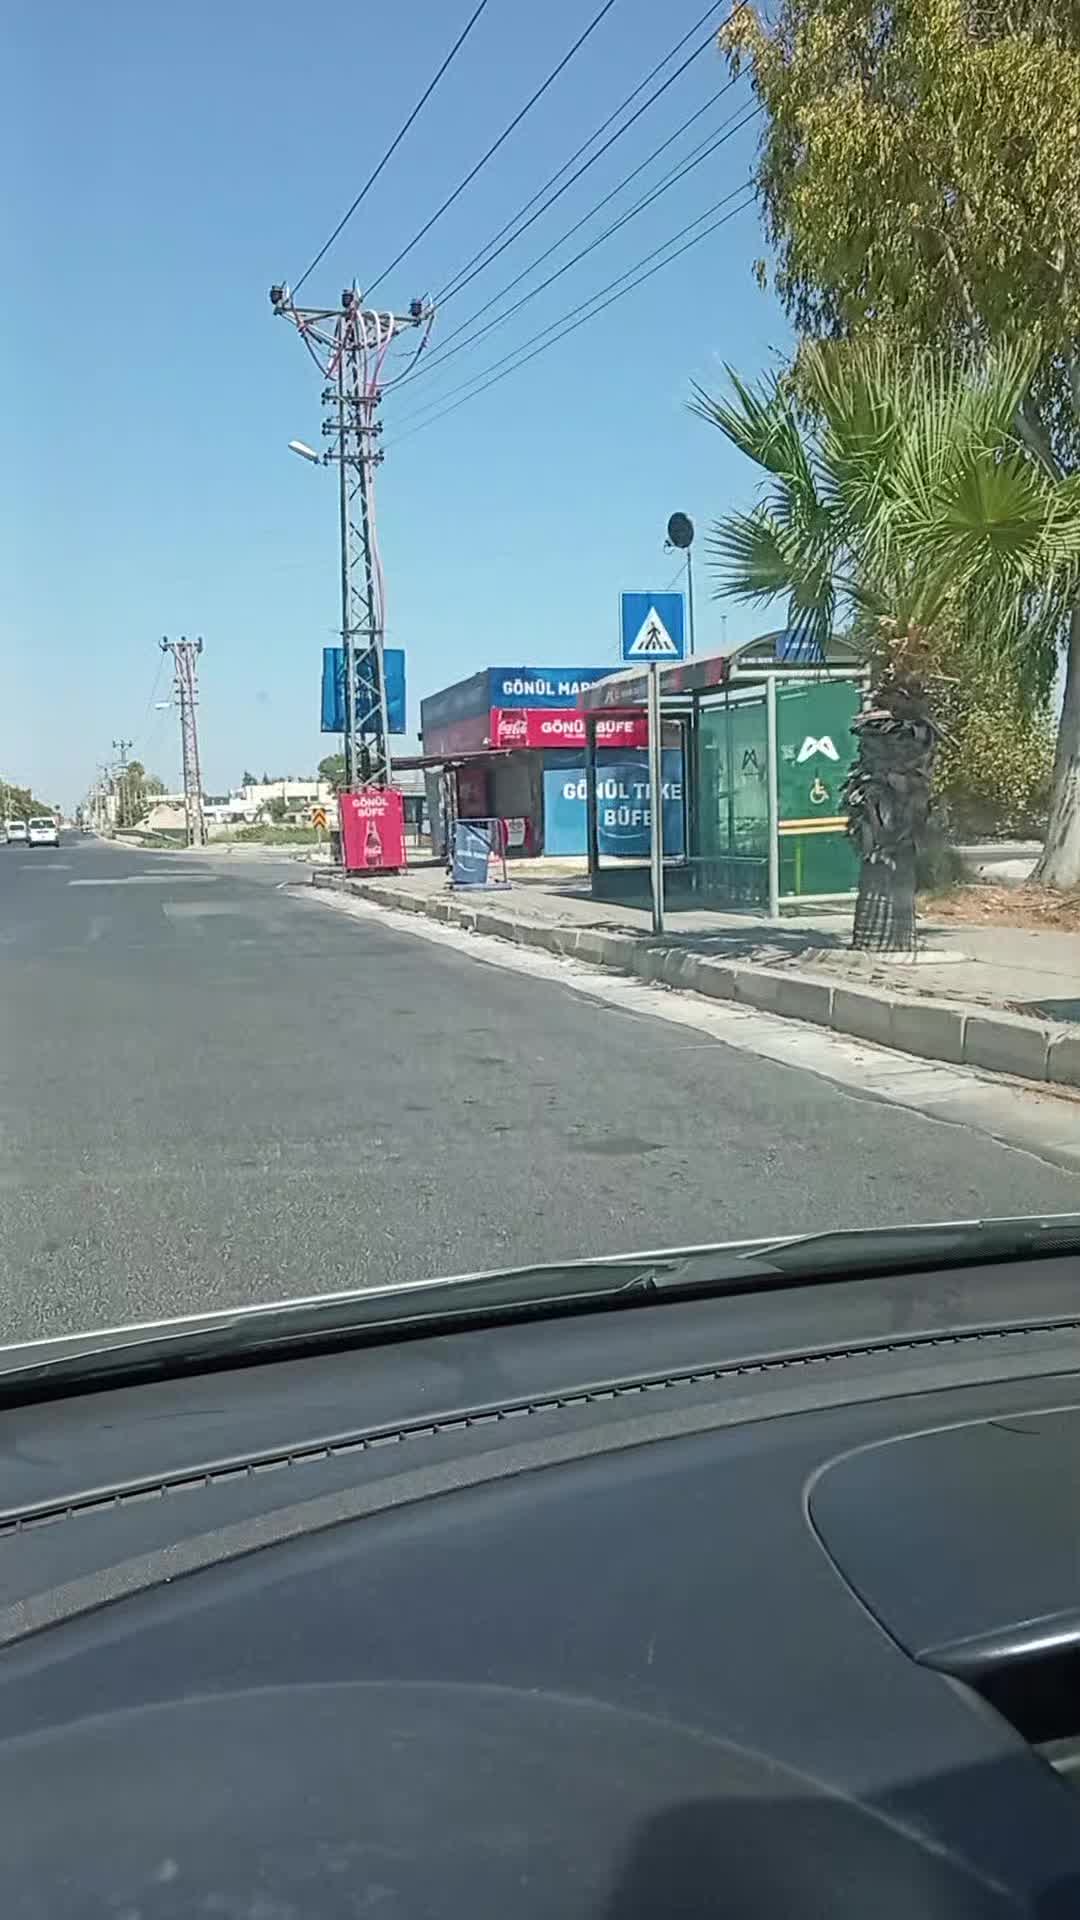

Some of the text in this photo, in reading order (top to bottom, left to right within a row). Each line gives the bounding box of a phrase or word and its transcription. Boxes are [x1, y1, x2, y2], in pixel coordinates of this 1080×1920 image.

[502, 679, 555, 696] GÖNÜL
[541, 719, 634, 733] GÖNÜ BÜFE
[563, 778, 630, 800] GÖNÜL
[352, 796, 389, 808] GÖNÜL
[357, 807, 385, 817] BÜFE
[604, 806, 653, 827] BÜFE
